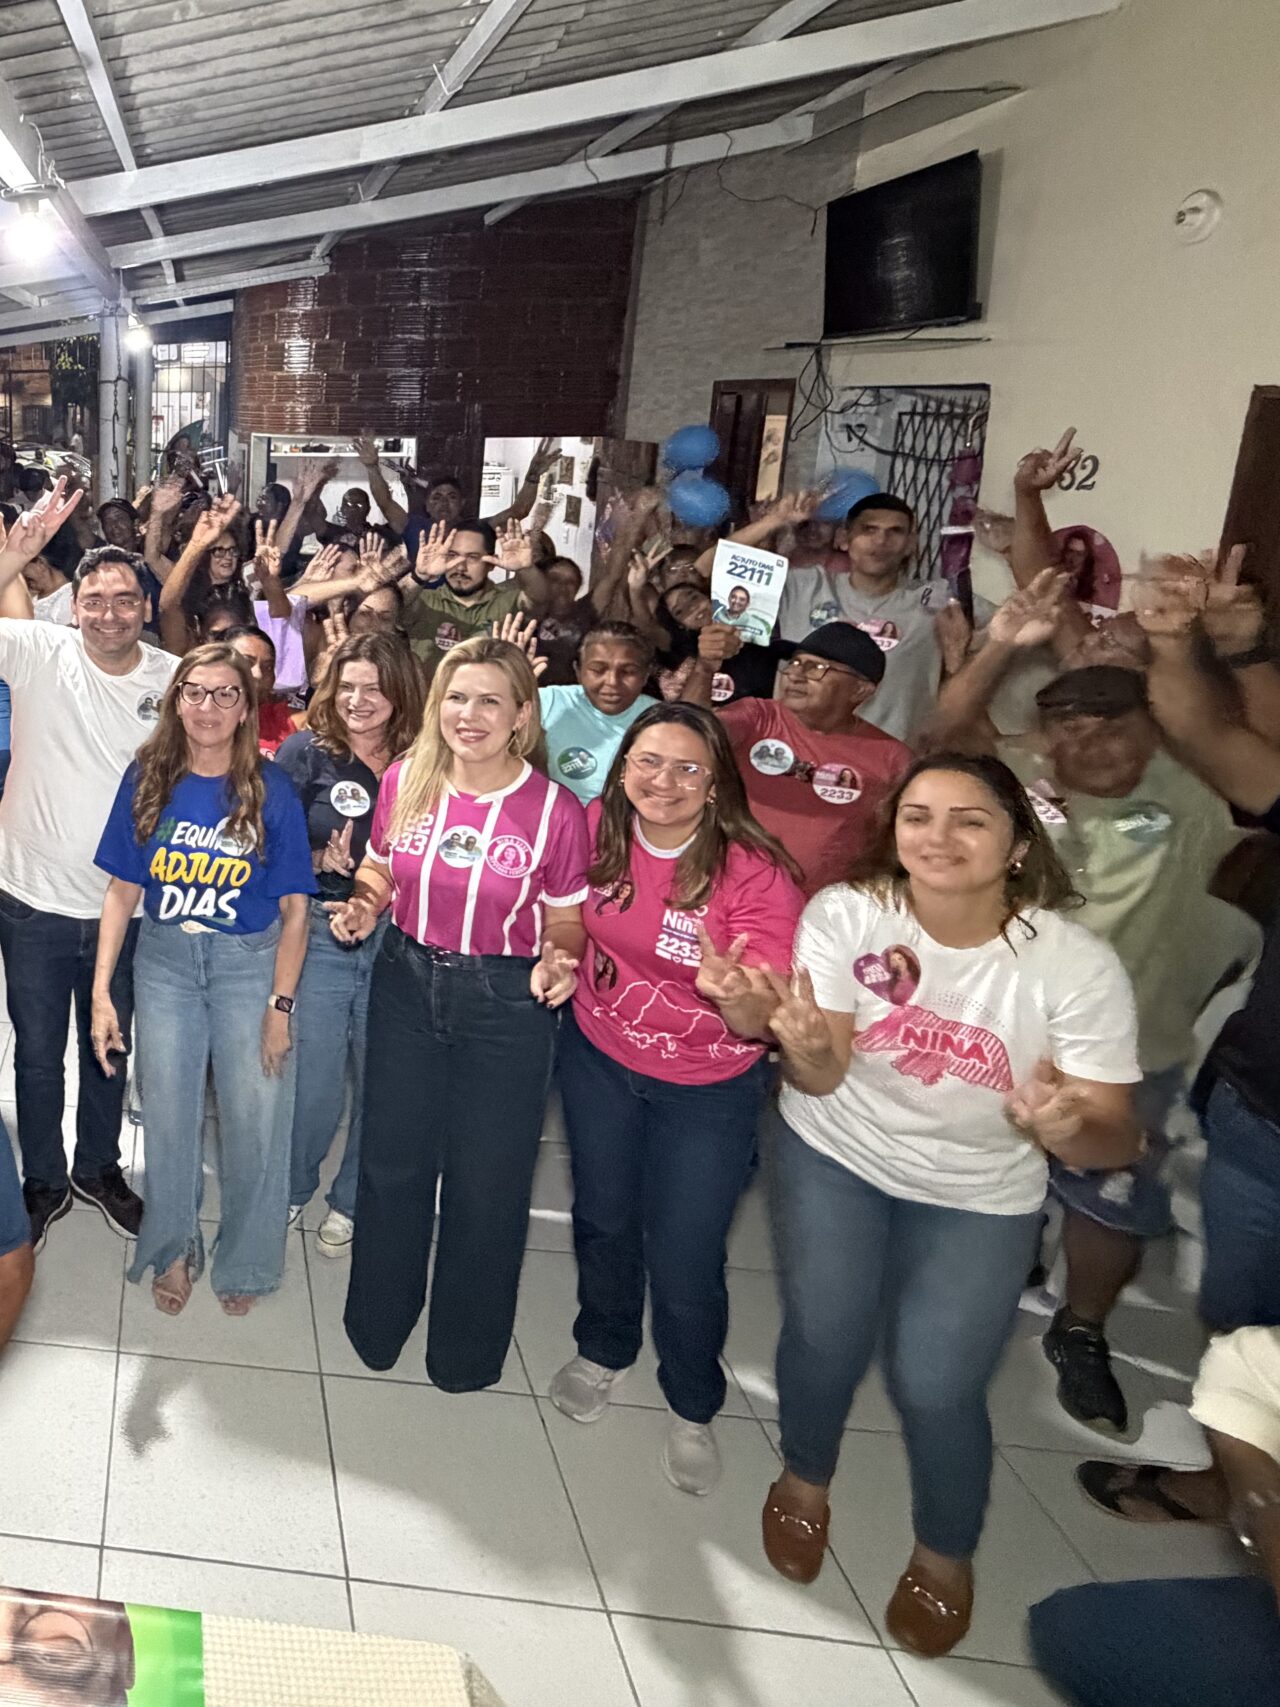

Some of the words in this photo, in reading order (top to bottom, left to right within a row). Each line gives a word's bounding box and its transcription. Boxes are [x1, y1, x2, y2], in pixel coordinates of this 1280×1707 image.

[726, 560, 773, 586] 22111
[820, 787, 855, 801] 2233
[150, 847, 251, 887] ADJUTO
[159, 884, 241, 920] DIAS
[656, 933, 702, 961] 2233
[901, 1025, 991, 1068] NINA
